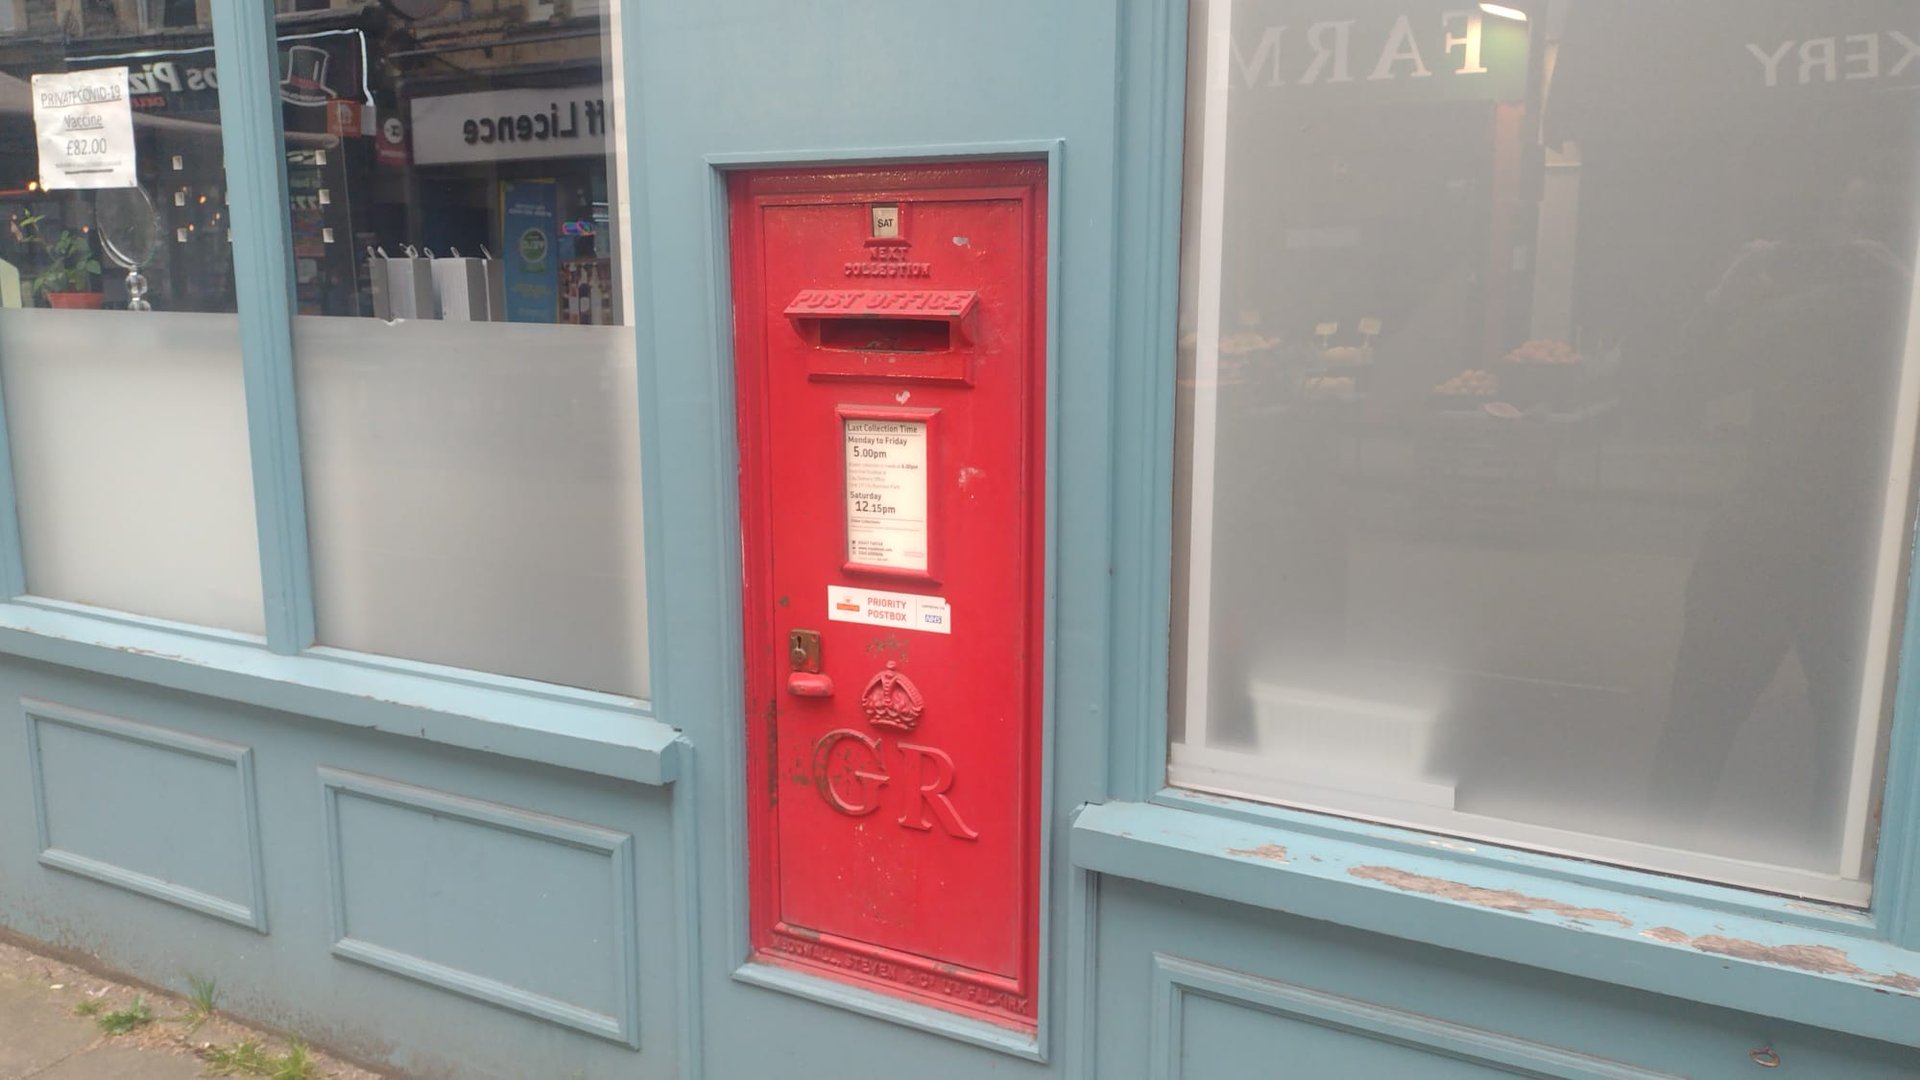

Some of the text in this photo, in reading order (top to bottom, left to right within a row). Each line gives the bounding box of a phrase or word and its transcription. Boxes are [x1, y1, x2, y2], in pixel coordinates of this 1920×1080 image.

[78, 84, 122, 103] COVID-19
[64, 113, 104, 128] Vaccine
[66, 137, 107, 156] £82.00
[877, 218, 894, 228] SAT
[869, 246, 910, 261] NEXT
[844, 262, 931, 278] COLLECTION
[789, 291, 971, 311] POST OFFICE
[847, 423, 918, 434] Last Collection Time
[847, 436, 907, 447] Monday to Friday
[853, 446, 887, 459] 5.00pm
[850, 491, 882, 501] Saturday
[855, 500, 896, 515] 12.15pm
[867, 597, 907, 611] PRIORITY
[867, 609, 907, 622] POSTBOX
[924, 614, 942, 624] NHS
[813, 728, 979, 841] GR
